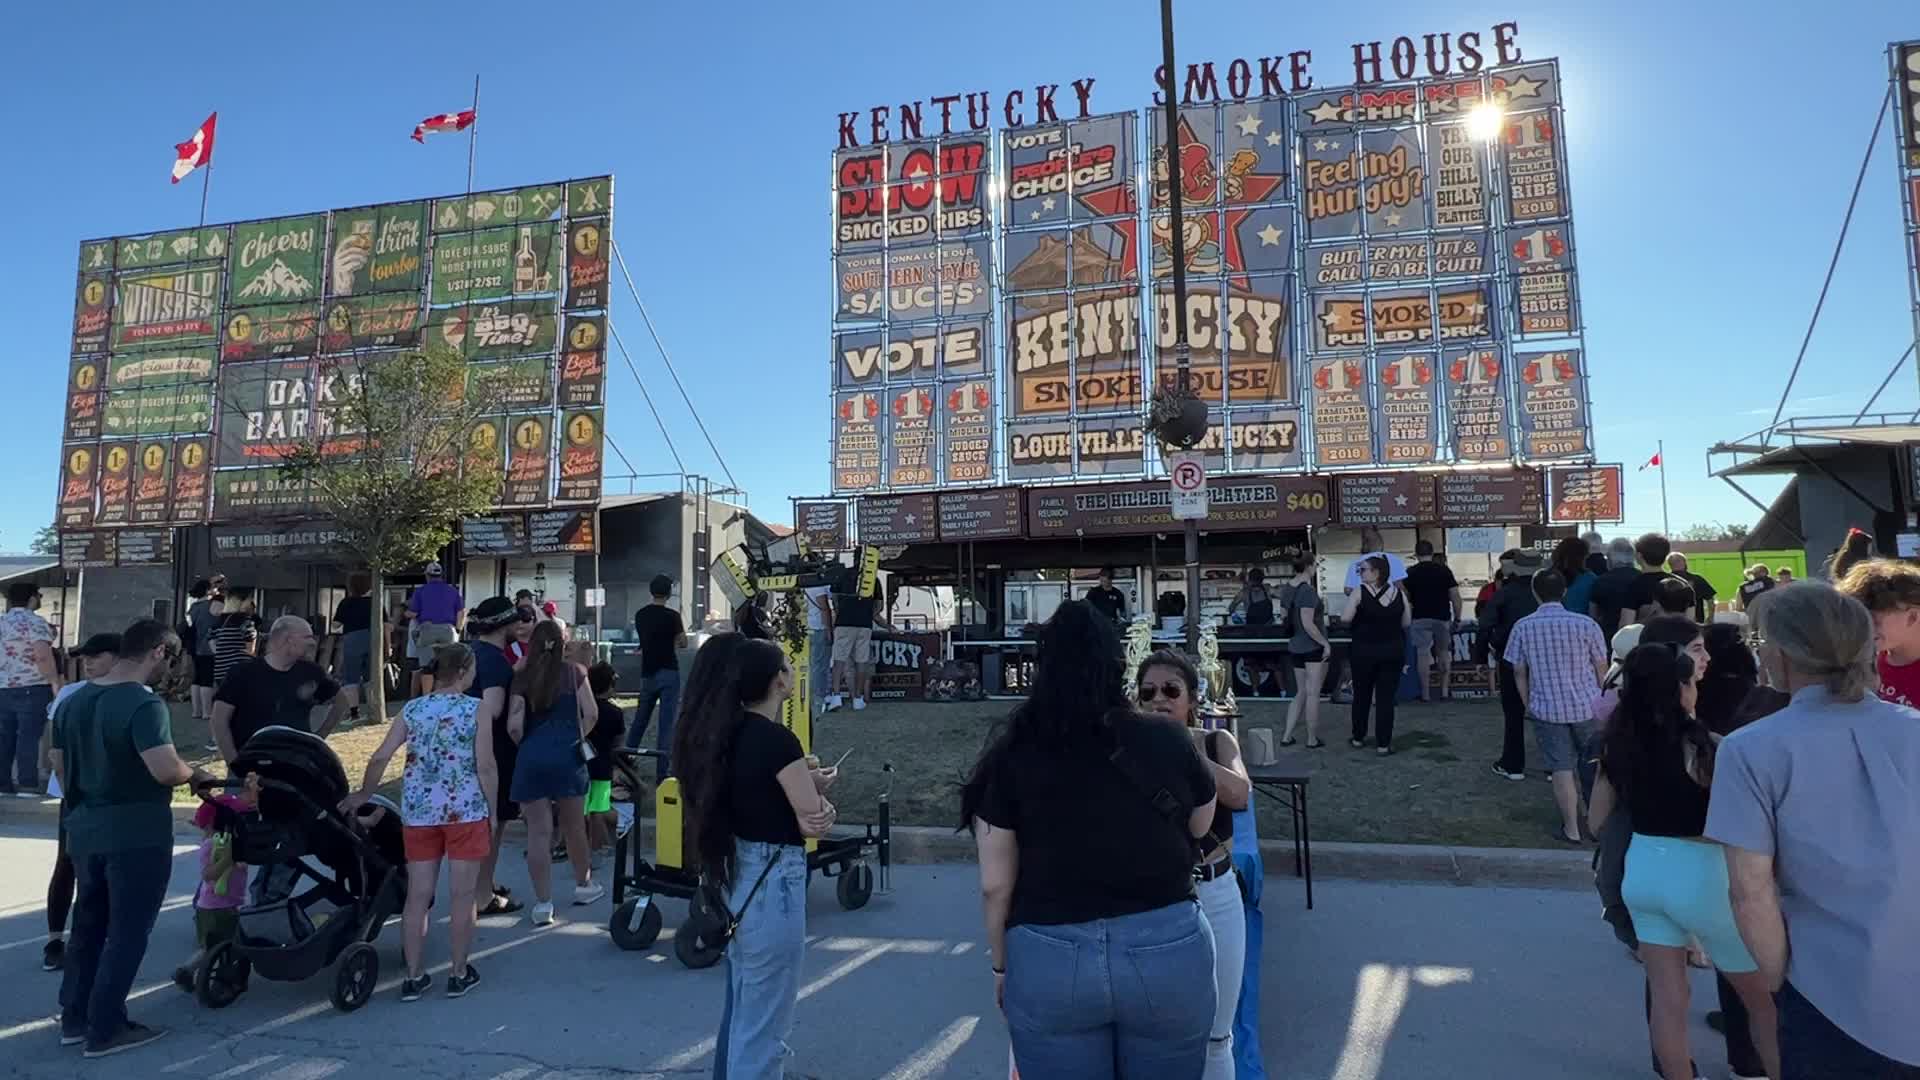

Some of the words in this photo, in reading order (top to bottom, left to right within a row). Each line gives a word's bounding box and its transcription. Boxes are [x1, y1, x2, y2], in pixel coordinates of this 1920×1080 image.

[838, 78, 1095, 148] KENTUCKY
[1351, 21, 1522, 84] HOUSE
[1008, 130, 1062, 149] VOTE
[1049, 144, 1081, 160] FOR
[1441, 149, 1474, 165] OUR
[1509, 148, 1552, 160] PLACE
[1013, 145, 1115, 181] PEOPLE'S
[1307, 147, 1406, 190] Feeling
[841, 143, 984, 217] SLOW
[1011, 162, 1112, 199] CHOICE
[1439, 168, 1478, 187] HILL
[1307, 168, 1423, 219] Hungry?
[1435, 188, 1483, 208] BILLY
[1511, 182, 1557, 199] RIBS
[841, 216, 929, 241] SMOKED
[935, 208, 982, 230] RIBS
[1437, 210, 1486, 225] PLATTER
[375, 219, 420, 254] drink
[240, 228, 315, 268] Cheers!
[440, 247, 461, 260] TAKE
[482, 241, 510, 254] SAUCE
[891, 255, 920, 264] ONNA
[923, 250, 950, 260] LOE
[952, 248, 975, 257] OUR
[1389, 245, 1415, 260] MY
[1463, 240, 1477, 254] &
[441, 261, 463, 273] HOME
[491, 257, 507, 268] YOU
[1317, 267, 1361, 283] CALL
[1387, 263, 1400, 276] A
[1520, 274, 1567, 286] TORONTO
[851, 282, 974, 314] SAUCES
[1520, 299, 1568, 313] SAUCE
[1351, 302, 1465, 326] SMOKED
[474, 313, 529, 333] BBQ
[474, 324, 539, 347] Time!
[1016, 294, 1281, 373] KENTUCKY
[1327, 331, 1415, 346] PULLED
[844, 330, 977, 378] VOTE
[1035, 376, 1142, 402] SMOKE
[1385, 391, 1428, 400] PLACE
[1454, 388, 1496, 397] PLACE
[1527, 388, 1571, 399] PLACE
[1526, 399, 1577, 412] WINDSOR
[896, 420, 929, 429] PLACE
[951, 415, 985, 424] PLACE
[1452, 412, 1500, 424] JUDGED
[841, 425, 875, 434] PLACE
[1390, 428, 1427, 439] RIBS
[1456, 424, 1498, 437] SAUCE
[949, 440, 989, 451] JUDGED
[952, 451, 985, 462] SAUCE
[562, 462, 600, 477] Sauce
[1075, 494, 1107, 510] THE
[1287, 492, 1324, 512] $40
[216, 536, 236, 549] THE
[238, 532, 317, 547] LUMBERJACK
